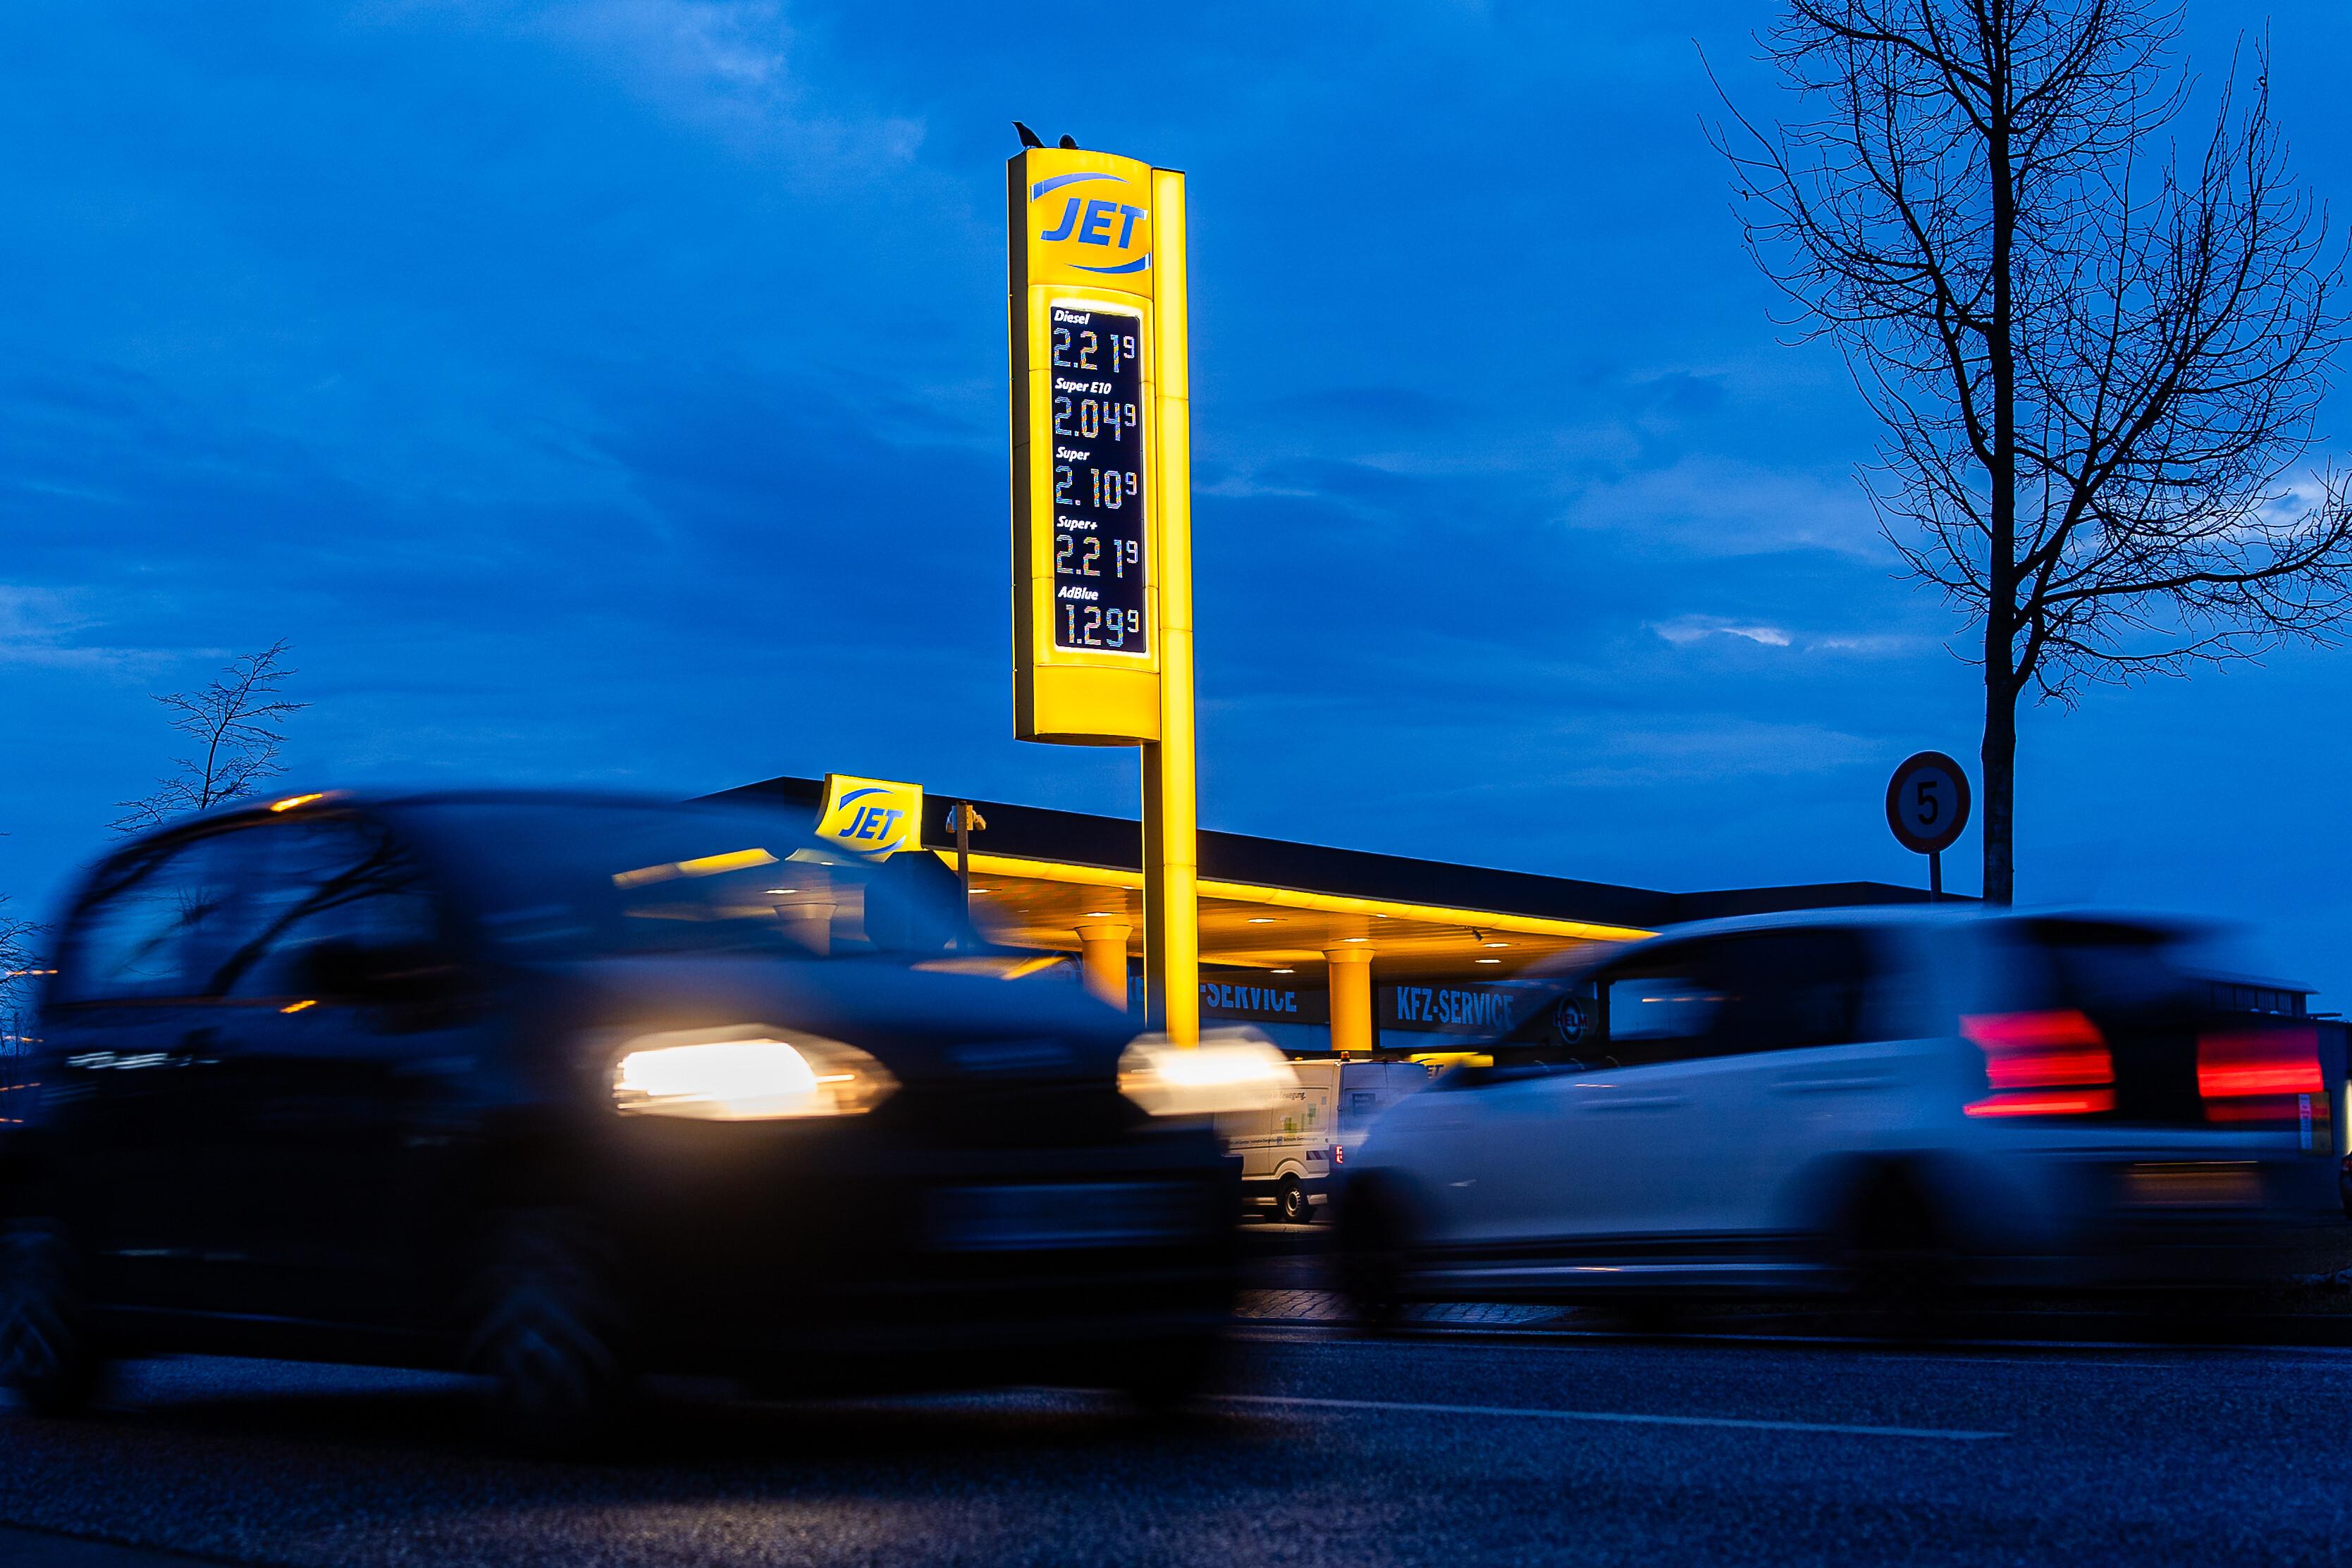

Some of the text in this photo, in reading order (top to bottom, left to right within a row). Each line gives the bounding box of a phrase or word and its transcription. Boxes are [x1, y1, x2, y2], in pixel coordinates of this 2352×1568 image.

[1040, 198, 1148, 249] JET
[1054, 310, 1090, 325] Diesel
[1055, 378, 1112, 395] Super E10
[1056, 446, 1090, 462] Super
[1057, 516, 1097, 531] Super+
[1058, 586, 1099, 600] AdBlue
[1918, 781, 1938, 825] 5
[838, 806, 904, 840] JET
[1397, 986, 1513, 1027] KFZ-SERVICE
[1553, 1013, 1589, 1029] HELM
[1425, 1064, 1443, 1079] ET
